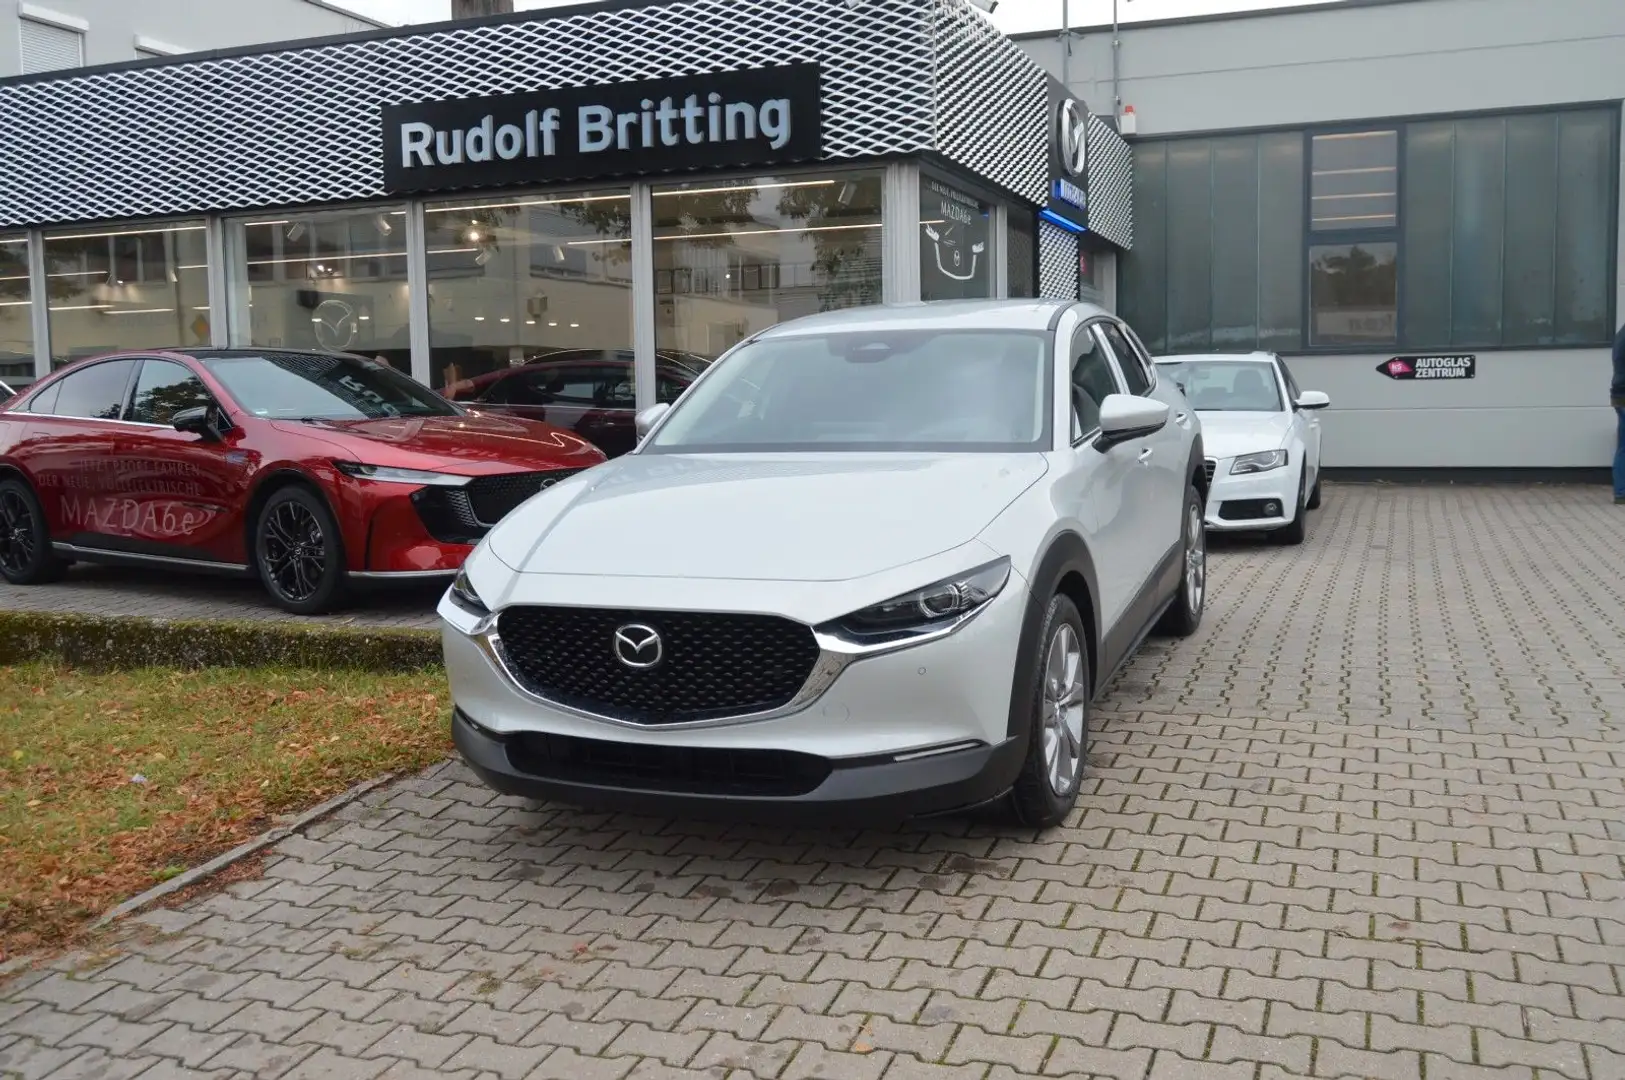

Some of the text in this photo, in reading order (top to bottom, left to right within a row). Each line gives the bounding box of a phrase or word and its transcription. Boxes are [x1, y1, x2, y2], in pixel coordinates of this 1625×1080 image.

[401, 92, 792, 168] Rudolf Britting
[1415, 367, 1466, 378] ZENTRUM
[1416, 357, 1471, 368] AUTOGLAS
[60, 495, 196, 536] MAZDA6e
